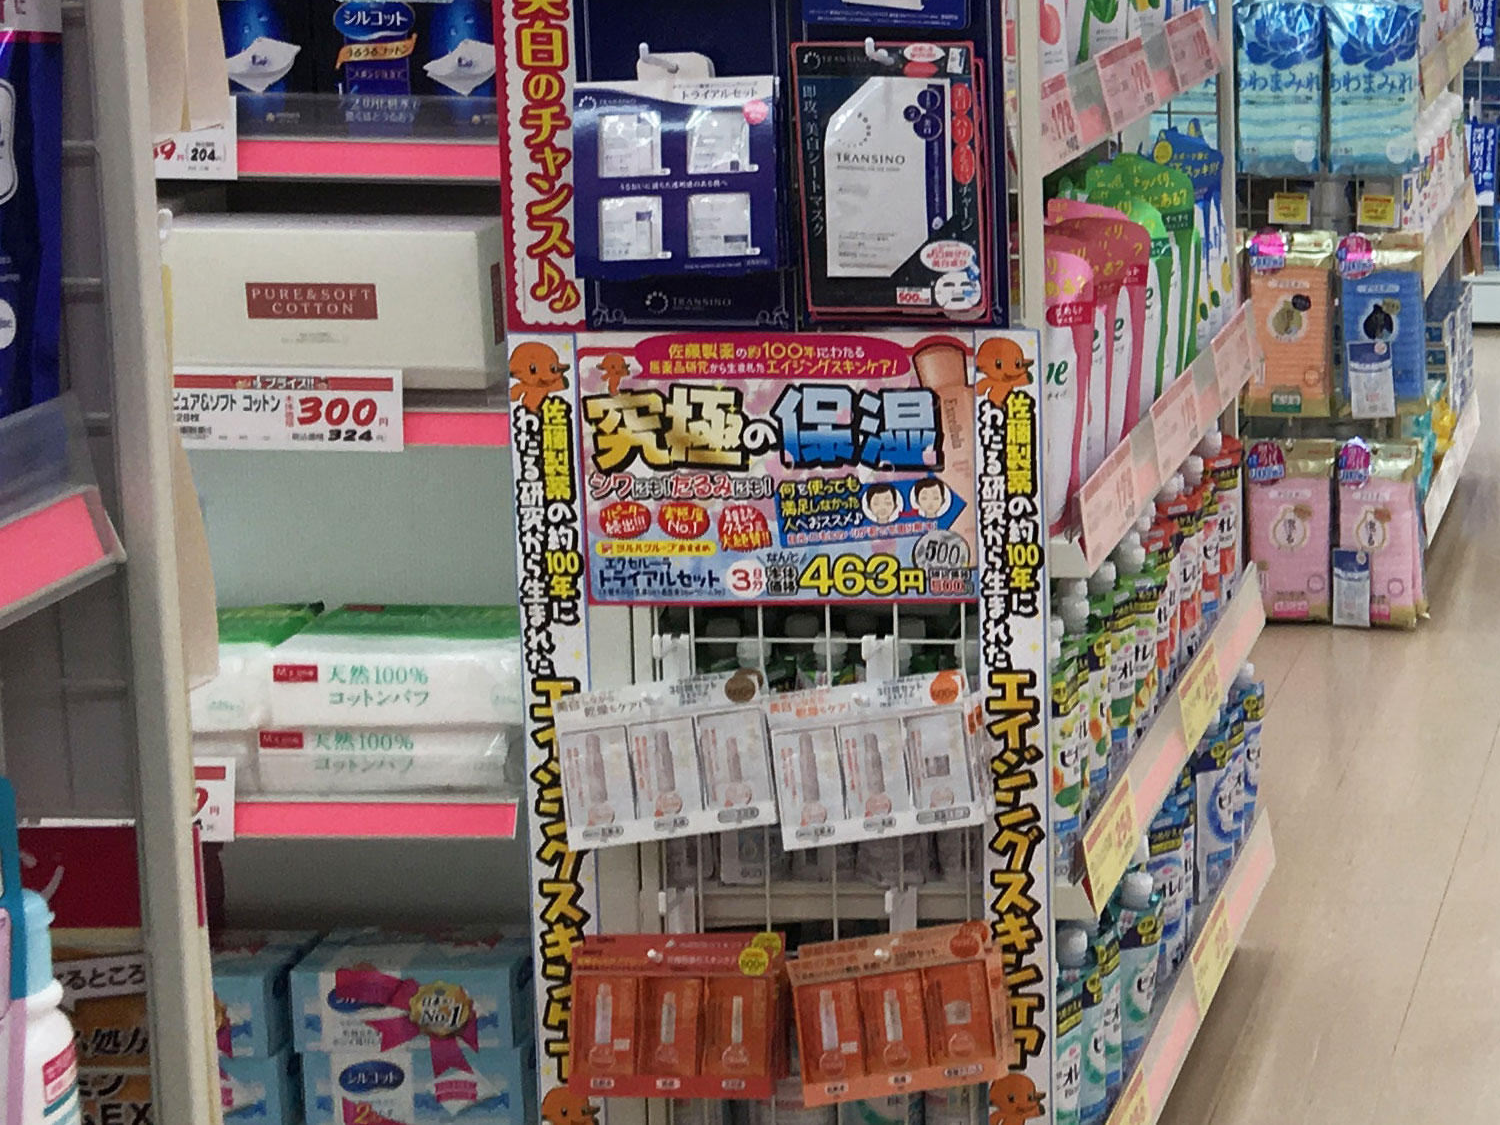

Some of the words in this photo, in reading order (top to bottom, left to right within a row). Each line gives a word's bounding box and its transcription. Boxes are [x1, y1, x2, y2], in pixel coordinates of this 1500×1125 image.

[343, 8, 409, 27] シルコット
[681, 88, 758, 102] トライアルセット
[189, 146, 217, 162] 204
[836, 151, 906, 166] TRANSINO
[251, 287, 372, 302] PURE&SOFT
[672, 296, 733, 308] TRANSINO
[271, 301, 355, 315] COTTON
[242, 394, 281, 413] コットン
[296, 396, 379, 428] 300
[327, 428, 374, 443] 324
[589, 474, 774, 501] シワにも!たるみにも!
[666, 516, 700, 535] No.1
[514, 409, 554, 674] わたる研究から生まれた
[979, 403, 1012, 668] わたる研究から生まれた
[599, 569, 721, 589] トライアルセット
[799, 554, 926, 597] 463円
[327, 664, 429, 686] 天然100%
[328, 689, 430, 708] コットンパフ
[315, 733, 414, 752] 天然100%
[313, 756, 414, 773] コットンパフ
[57, 963, 146, 991] るところ
[421, 1004, 461, 1027] No.1
[346, 1072, 396, 1085] シルコット
